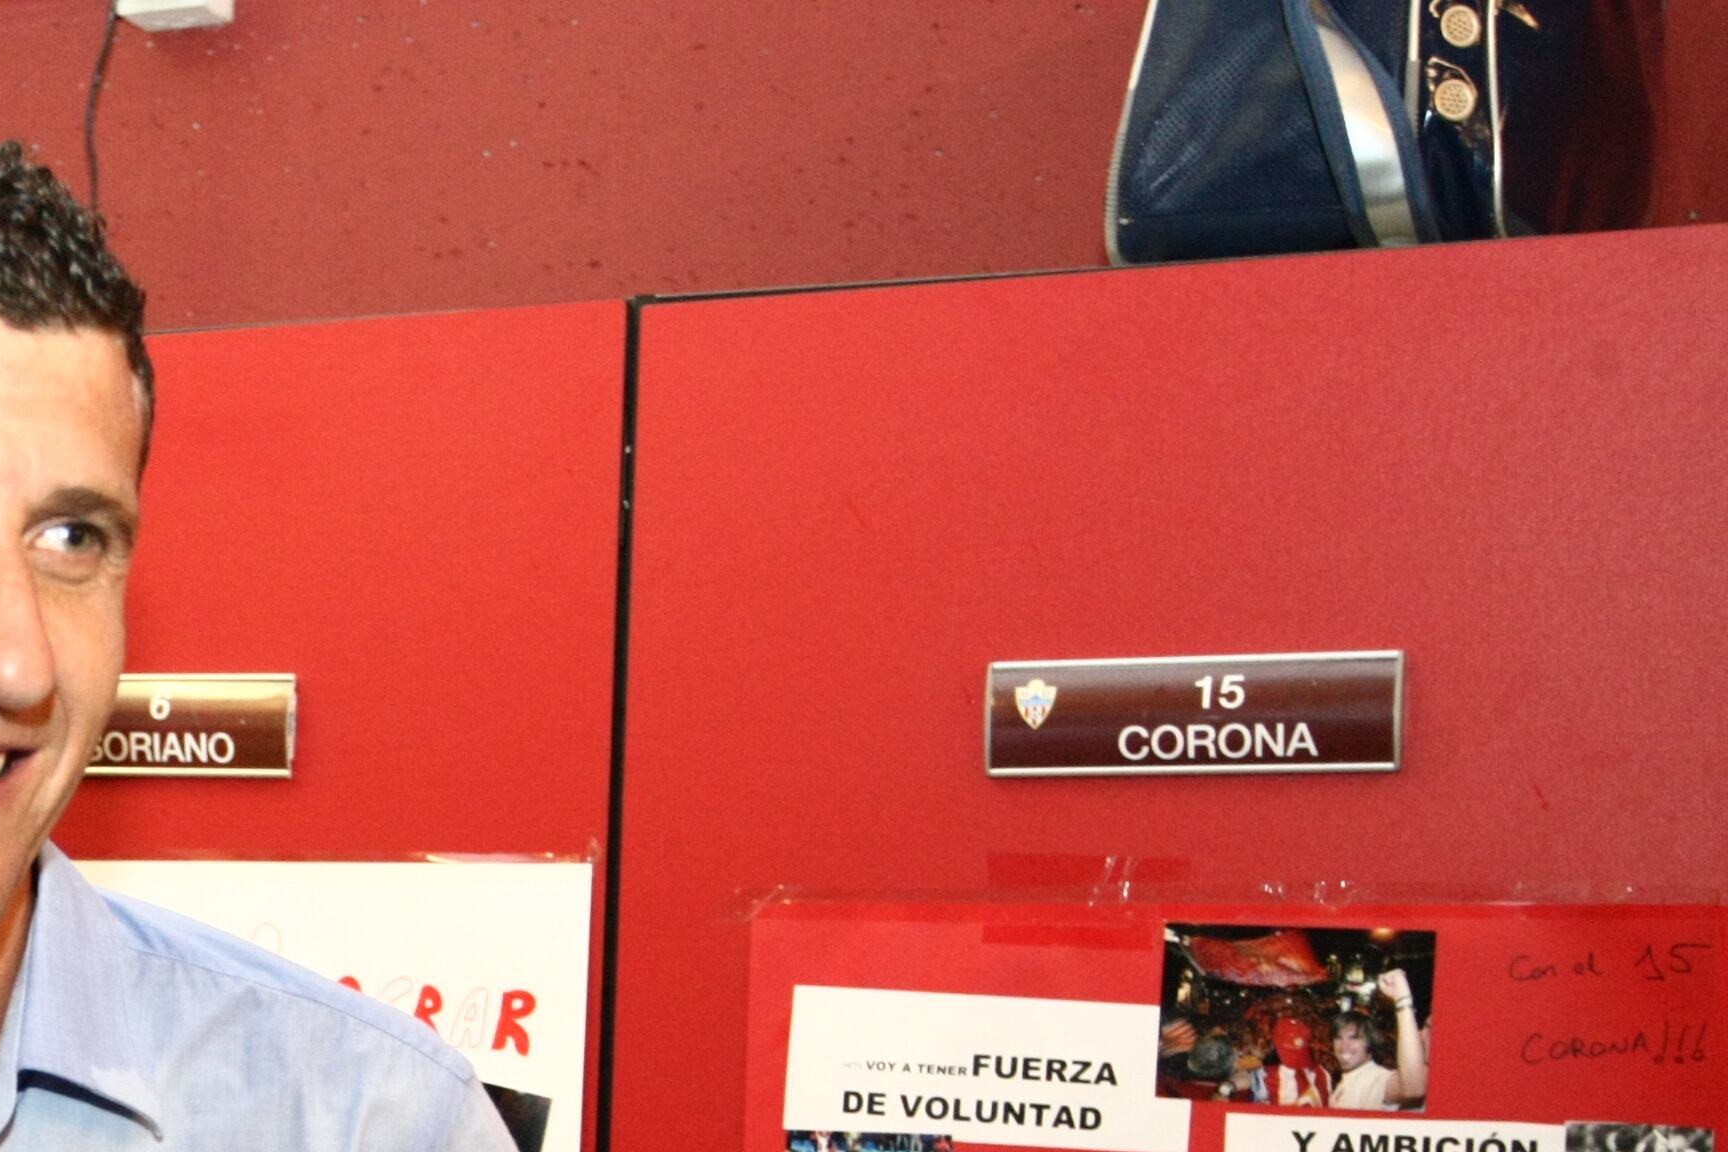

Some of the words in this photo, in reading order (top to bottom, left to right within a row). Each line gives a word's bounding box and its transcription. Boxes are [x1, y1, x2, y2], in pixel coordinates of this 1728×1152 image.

[149, 687, 172, 720] 6
[1194, 673, 1246, 710] 15
[1117, 723, 1319, 761] CORONA
[1635, 943, 1713, 981] 15
[865, 1060, 897, 1073] VOY
[902, 1062, 912, 1074] A
[918, 1063, 968, 1077] TENER
[972, 1054, 1118, 1086] FUERZA
[842, 1090, 887, 1116] DE
[900, 1094, 1102, 1131] VOLUNTAD
